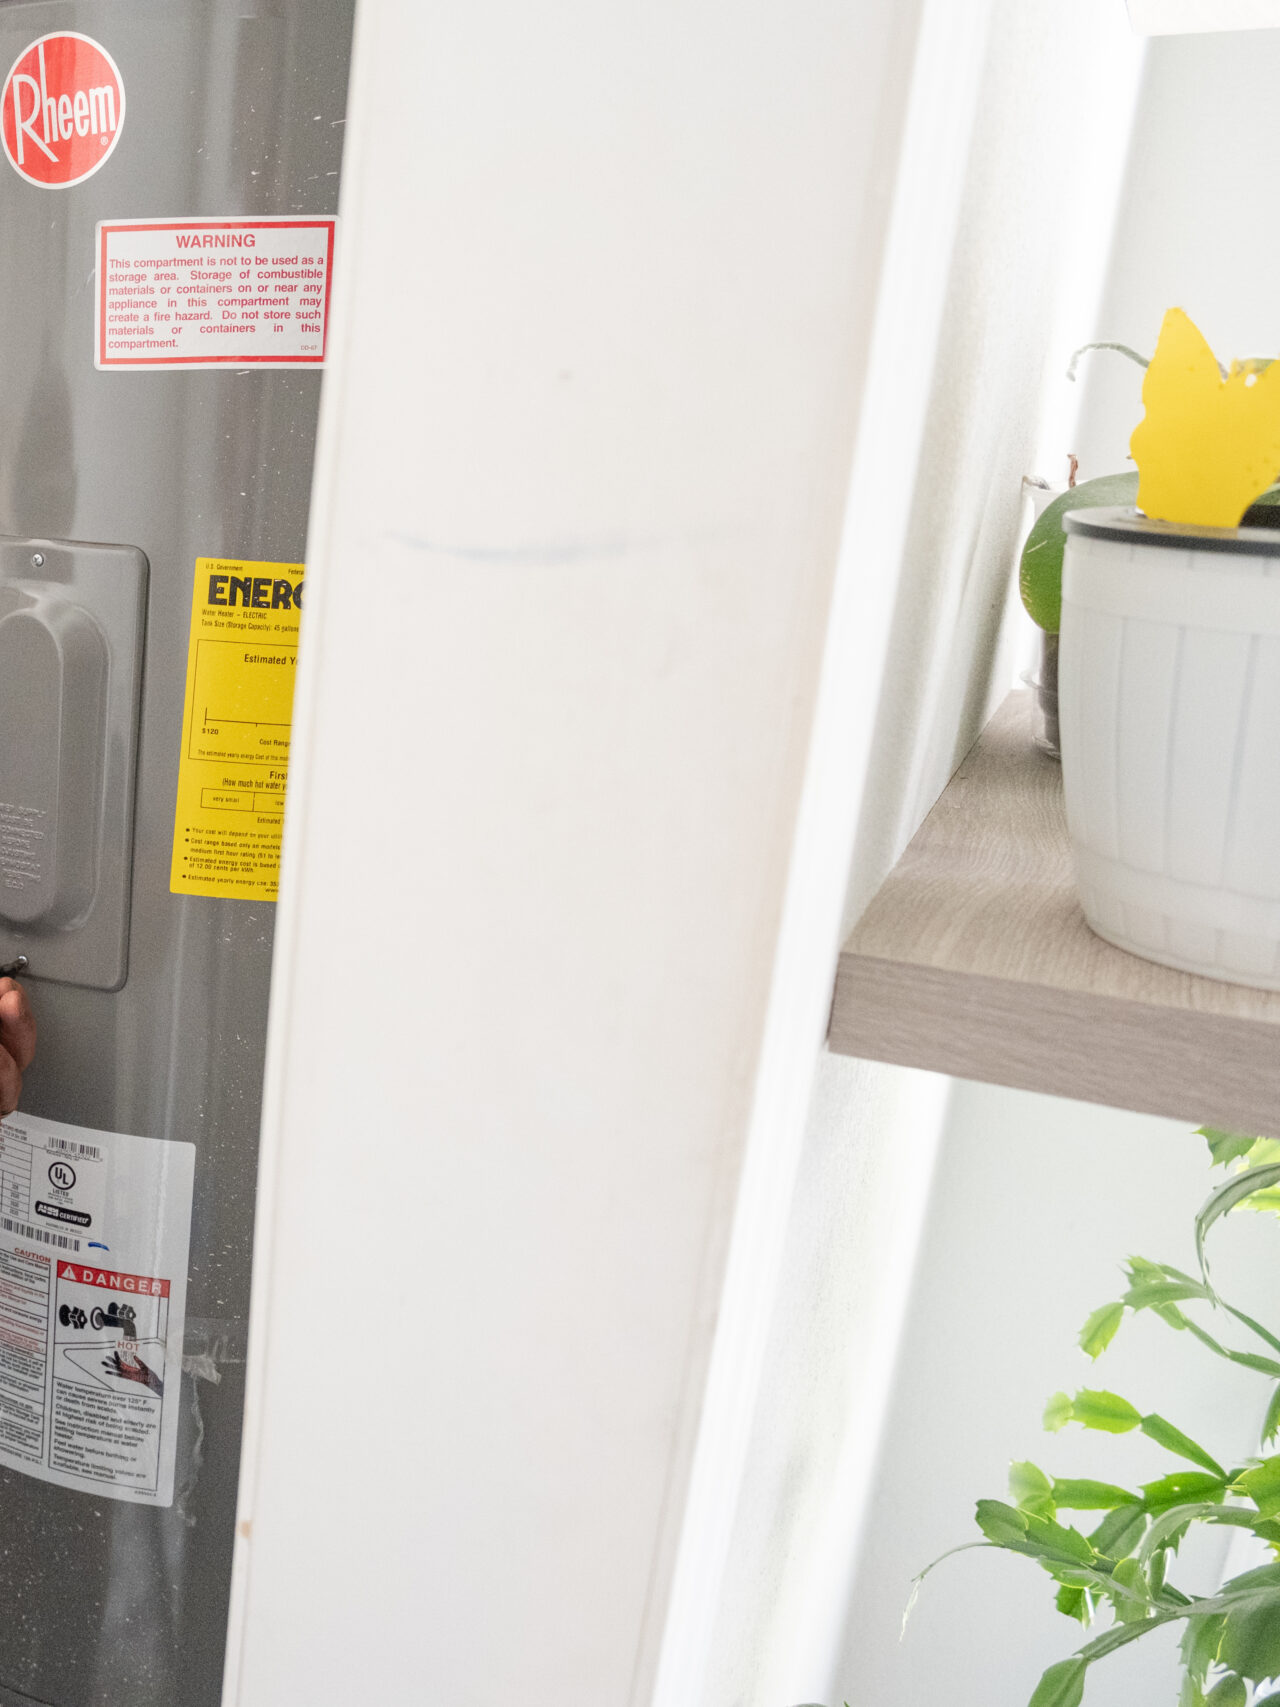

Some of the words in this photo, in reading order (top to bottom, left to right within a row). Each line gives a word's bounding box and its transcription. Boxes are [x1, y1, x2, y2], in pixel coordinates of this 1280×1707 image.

[13, 41, 116, 165] Rheem
[176, 234, 256, 249] WARNING
[109, 259, 130, 269] This
[133, 257, 203, 270] compartment
[207, 257, 216, 266] is
[220, 256, 237, 266] not
[241, 256, 252, 266] to
[255, 256, 269, 265] be
[272, 256, 298, 265] used
[301, 257, 314, 265] as
[317, 257, 324, 265] a
[109, 272, 147, 283] storage
[154, 273, 179, 281] area.
[190, 270, 232, 281] Storage
[239, 270, 250, 280] of
[257, 269, 323, 279] combustible
[109, 285, 155, 296] materials
[160, 286, 171, 294] or
[176, 283, 232, 294] containers
[238, 285, 252, 293] on
[257, 284, 269, 292] or
[274, 284, 298, 292] near
[303, 284, 323, 295] any
[108, 299, 157, 311] appliance
[168, 299, 177, 308] in
[187, 298, 207, 307] this
[217, 297, 289, 309] compartment
[299, 299, 322, 308] may
[108, 313, 139, 322] create
[154, 312, 171, 321] fire
[175, 312, 213, 321] hazard.
[222, 311, 237, 320] Do
[242, 311, 259, 319] not
[263, 311, 291, 319] store
[295, 310, 321, 319] such
[108, 326, 154, 335] materials
[171, 326, 182, 334] or
[200, 324, 256, 334] containers
[274, 324, 283, 333] in
[301, 323, 321, 333] this
[108, 339, 179, 350] compartment.
[243, 611, 267, 619] ELECTRIC
[244, 654, 286, 664] Estimated
[222, 778, 236, 786] (How
[238, 779, 253, 787] much
[255, 780, 264, 788] hot
[265, 781, 281, 789] water
[55, 1167, 69, 1185] UL
[14, 1247, 51, 1263] CAUTION
[83, 1270, 162, 1295] DANGER
[118, 1341, 139, 1351] HOT
[56, 1382, 73, 1390] Water
